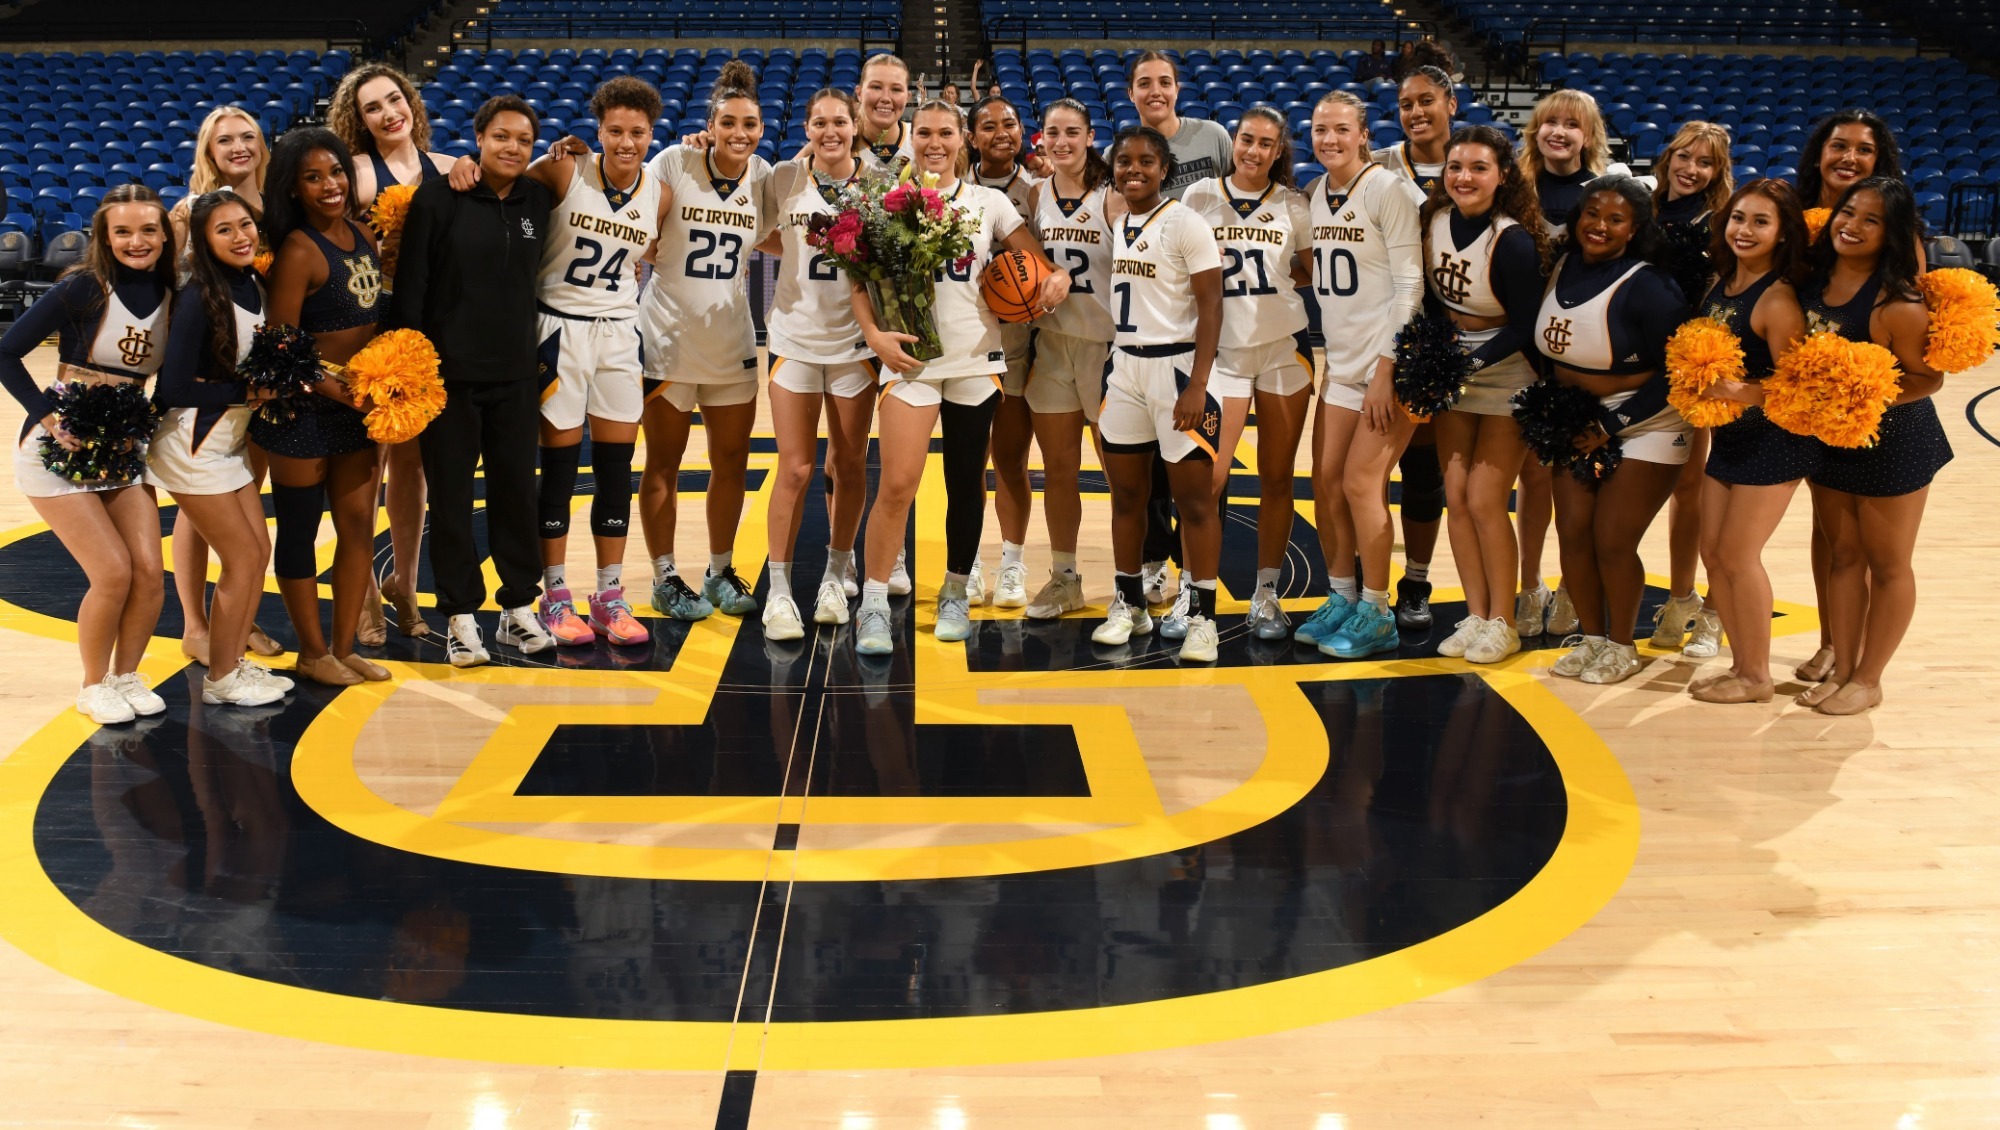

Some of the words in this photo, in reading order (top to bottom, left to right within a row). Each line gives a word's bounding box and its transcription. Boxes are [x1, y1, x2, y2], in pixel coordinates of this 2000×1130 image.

[1174, 169, 1215, 186] SKETBALL
[1178, 158, 1212, 174] IRVINE
[569, 211, 593, 230] UC
[594, 218, 648, 246] IRVINE
[681, 206, 703, 222] UC
[705, 209, 755, 230] IRVINE
[1051, 227, 1101, 245] IRVINE
[1212, 227, 1224, 241] C
[1227, 227, 1283, 246] IRVINE
[1320, 226, 1364, 243] IRVINE
[564, 236, 629, 292] 24
[685, 229, 743, 279] 23
[1116, 259, 1156, 279] IRVINE
[1222, 248, 1278, 297] 21
[1313, 247, 1359, 297] 10
[1114, 282, 1137, 333] 1
